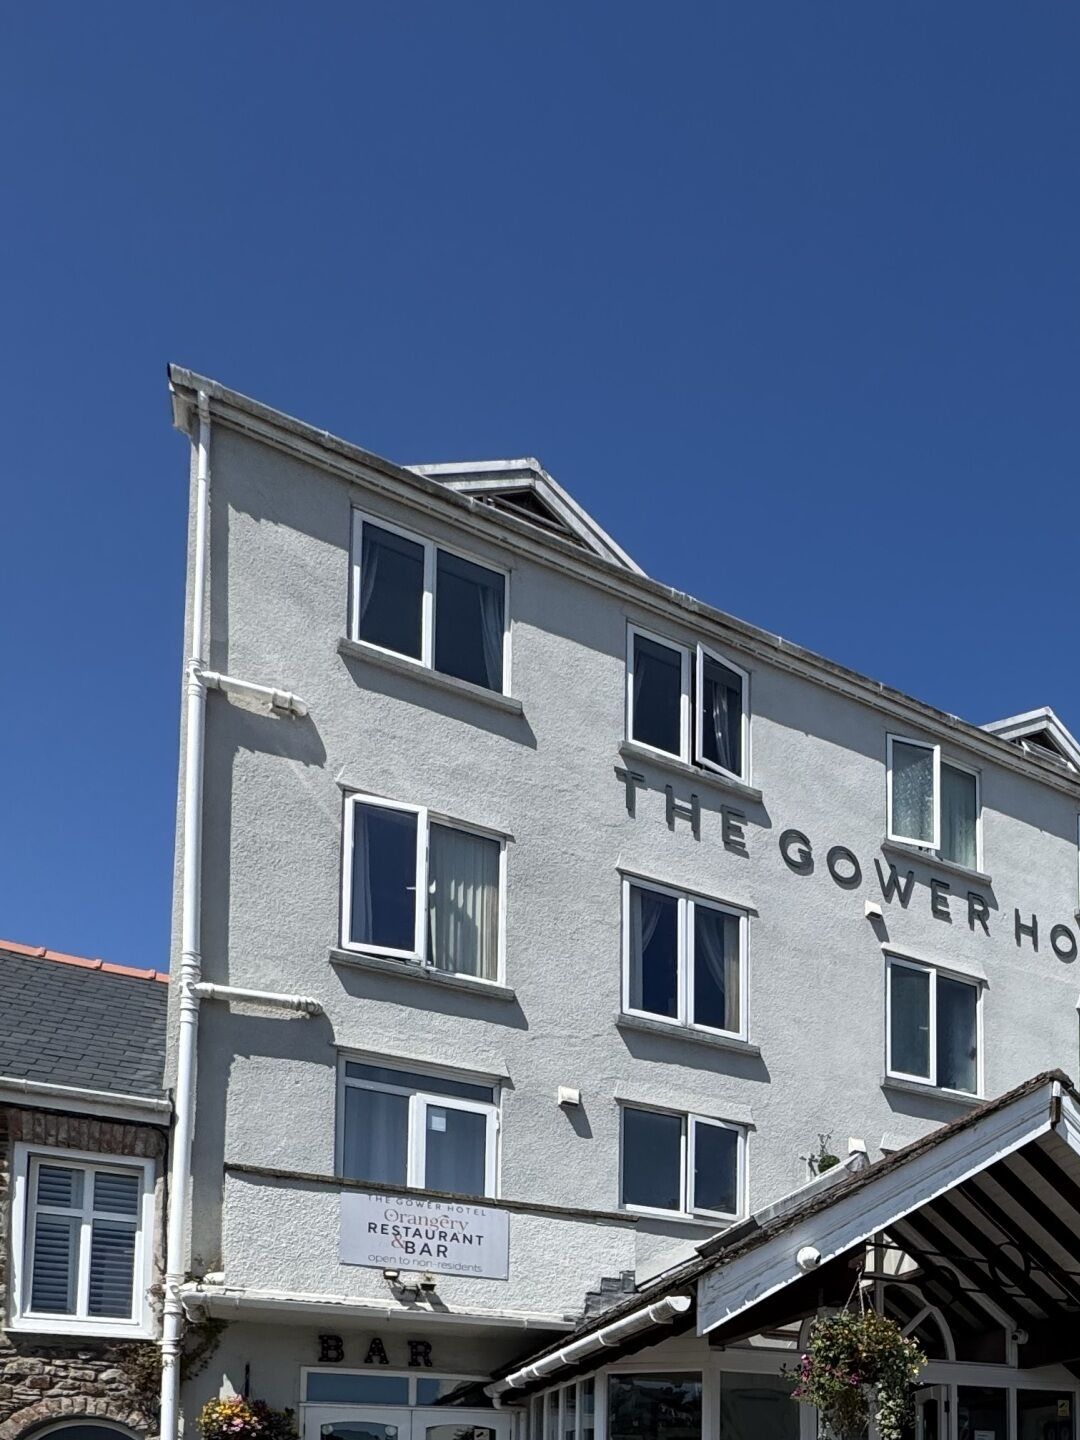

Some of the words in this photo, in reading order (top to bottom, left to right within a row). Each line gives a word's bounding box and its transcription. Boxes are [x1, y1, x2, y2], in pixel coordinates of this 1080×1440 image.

[614, 766, 747, 854] THE
[779, 829, 990, 935] GOWER
[396, 1197, 441, 1210] GOWER
[447, 1205, 487, 1217] HOTEL
[384, 1208, 469, 1234] Orangery
[368, 1222, 484, 1246] RESTAURANT
[391, 1234, 406, 1249] &
[405, 1241, 449, 1258] BAR
[368, 1254, 397, 1264] open
[400, 1255, 410, 1265] to
[412, 1258, 483, 1273] non-residents
[318, 1335, 432, 1367] BAR
